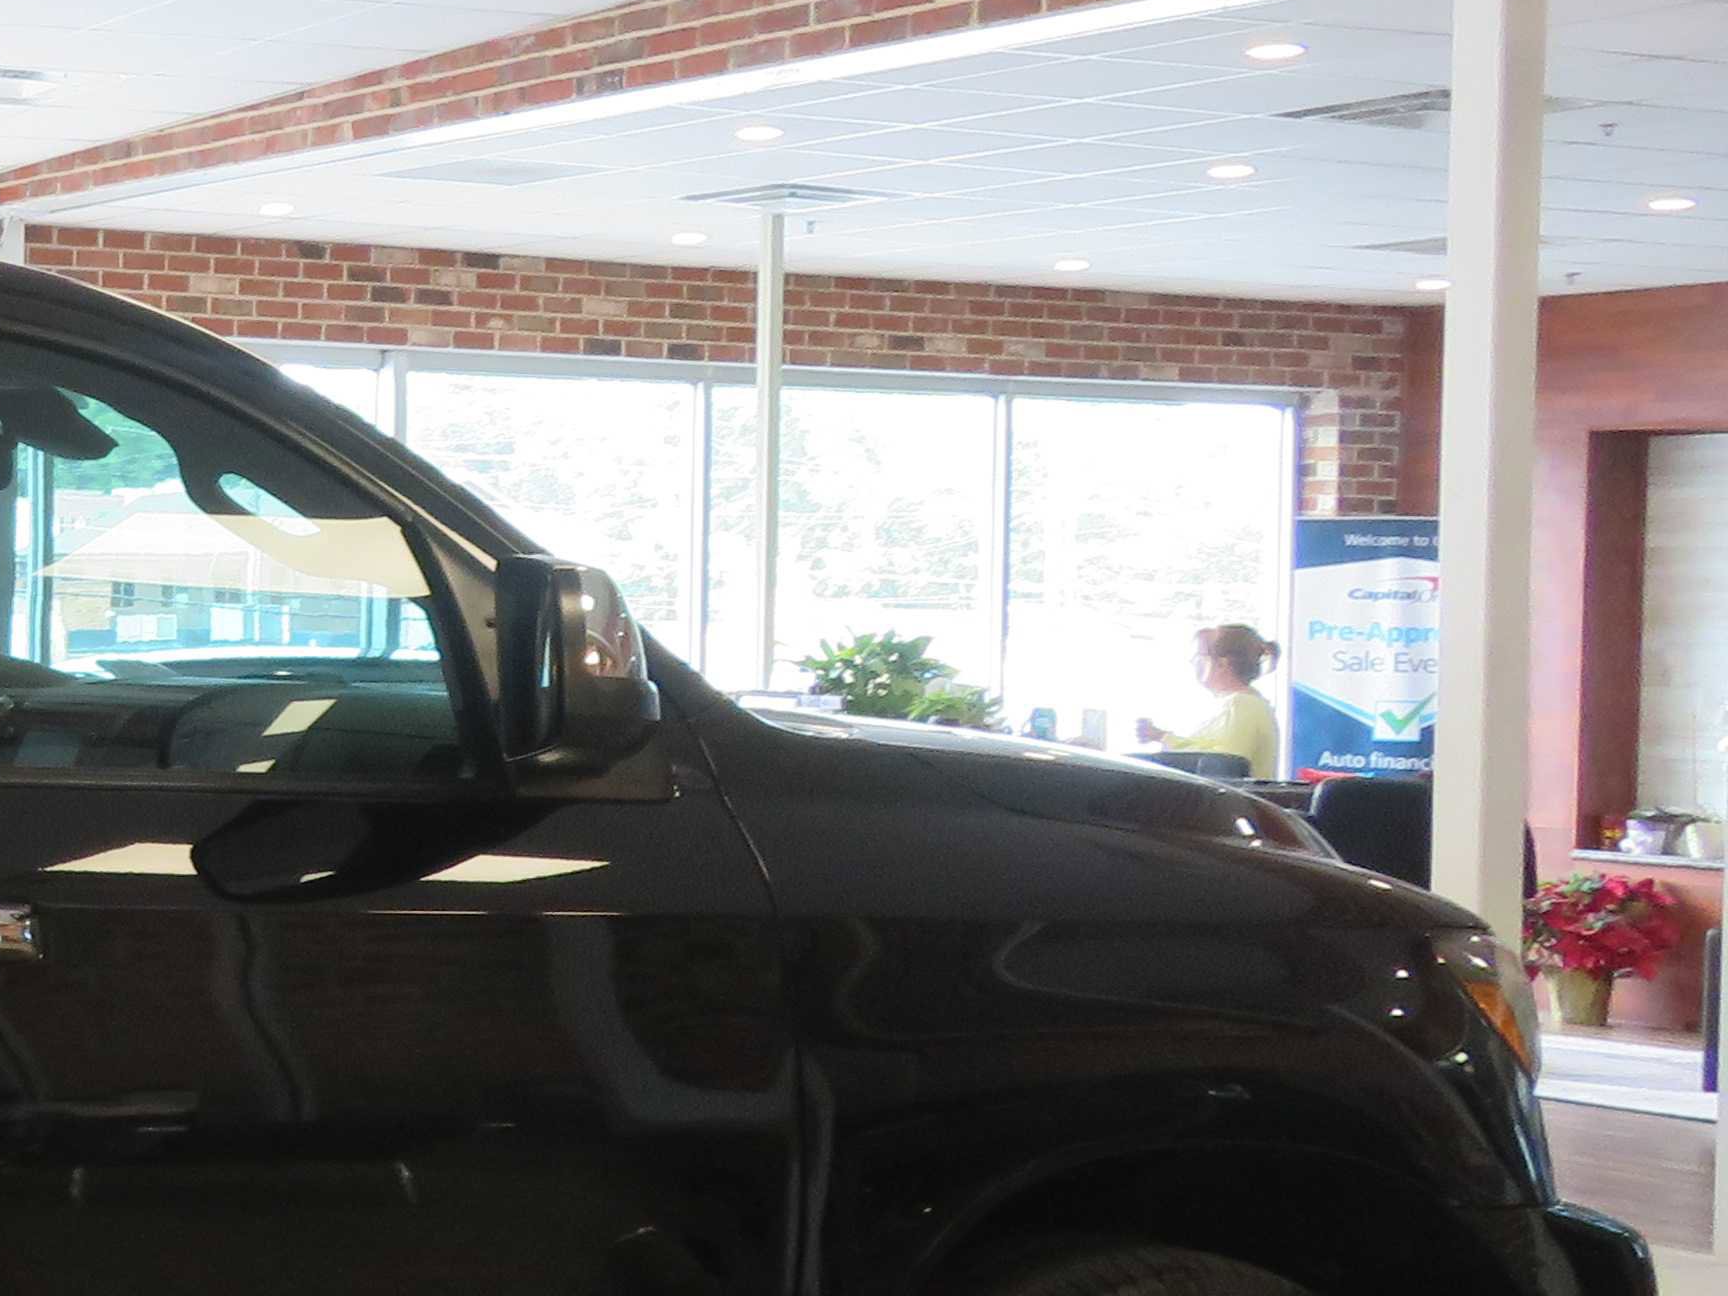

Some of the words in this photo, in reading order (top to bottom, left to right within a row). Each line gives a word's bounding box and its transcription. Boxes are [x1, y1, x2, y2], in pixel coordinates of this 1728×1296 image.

[1345, 534, 1408, 546] Welcome
[1413, 535, 1429, 546] to
[1347, 588, 1419, 603] Capital
[1332, 650, 1384, 672] Sale
[1317, 751, 1366, 768] Auto
[1370, 752, 1435, 770] financ
